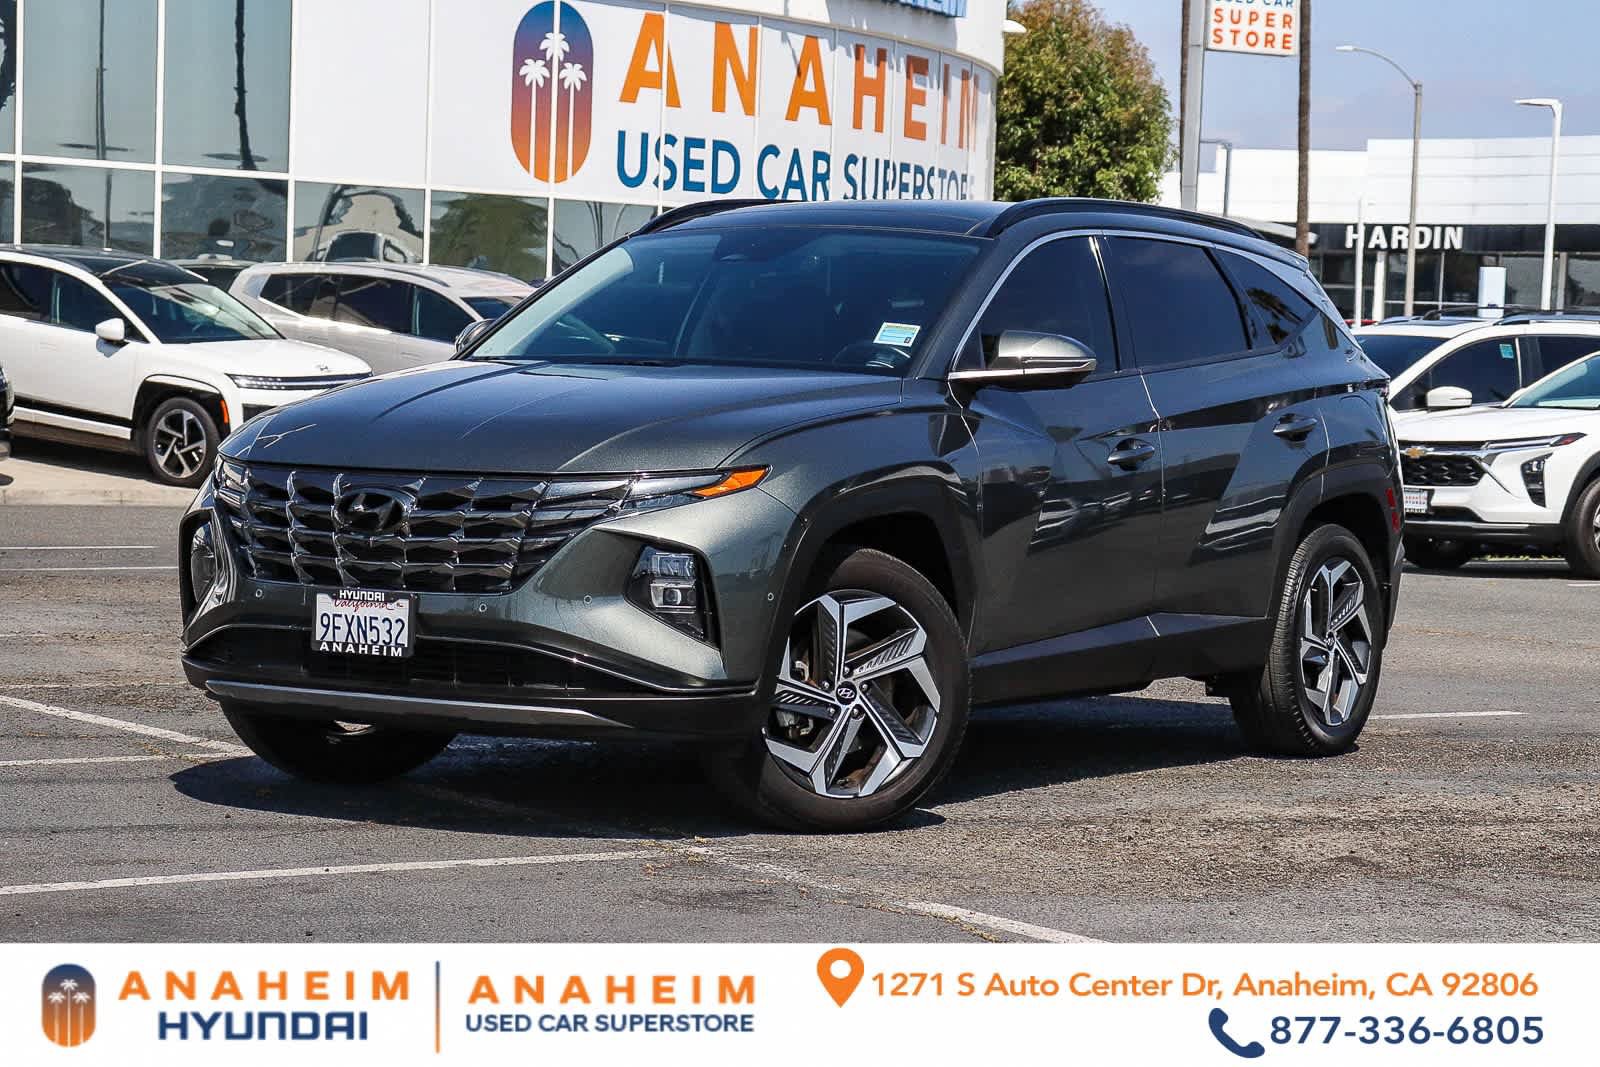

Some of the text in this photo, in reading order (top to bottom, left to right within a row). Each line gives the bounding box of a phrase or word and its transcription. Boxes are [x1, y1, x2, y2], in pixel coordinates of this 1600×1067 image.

[1213, 8, 1293, 29] SUPER
[1212, 28, 1292, 50] STORE
[619, 12, 979, 153] ANAHEIM
[617, 130, 741, 195] USED
[757, 144, 832, 200] CAR
[1345, 224, 1464, 250] HARDIN
[339, 589, 385, 602] HYUNDAI
[320, 612, 406, 647] 9FXN532
[319, 641, 402, 657] ANAHEIM
